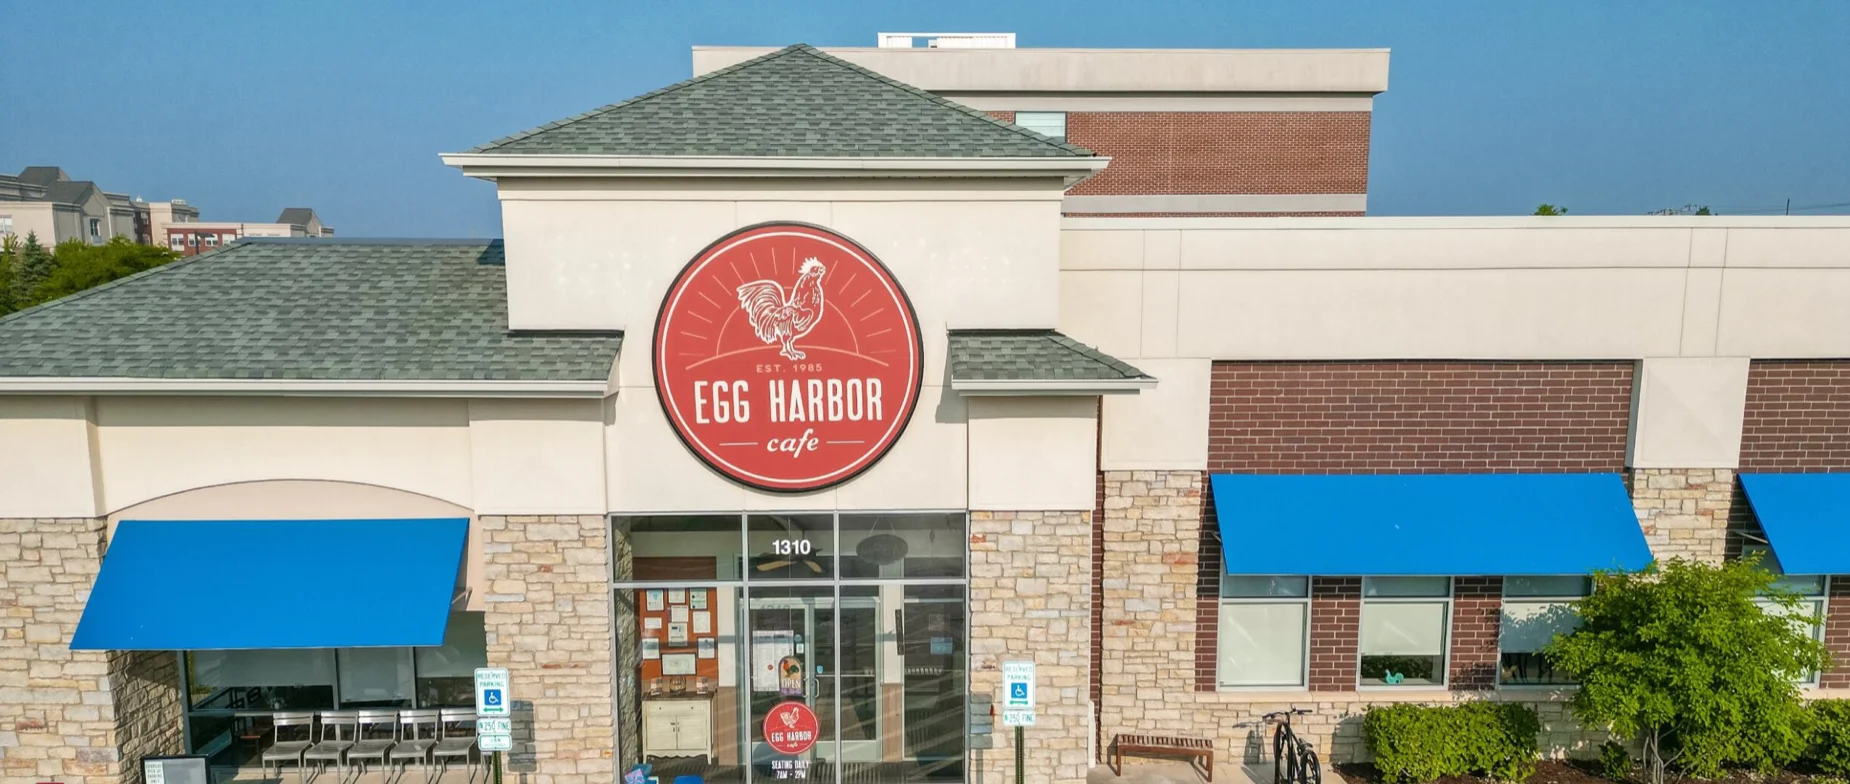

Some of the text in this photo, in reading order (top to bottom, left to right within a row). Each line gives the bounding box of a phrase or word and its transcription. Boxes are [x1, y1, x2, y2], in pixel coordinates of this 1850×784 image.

[756, 363, 823, 373] EST. 1985
[694, 378, 882, 424] EGG HARBOR
[766, 428, 819, 458] cafe
[772, 539, 811, 555] 1310
[781, 679, 801, 688] OPEN
[497, 721, 510, 730] FINE
[771, 731, 812, 742] EGG HARBOR
[771, 760, 809, 769] SEATING DAILY
[776, 770, 788, 779] 7AM
[794, 770, 806, 779] 2PM
